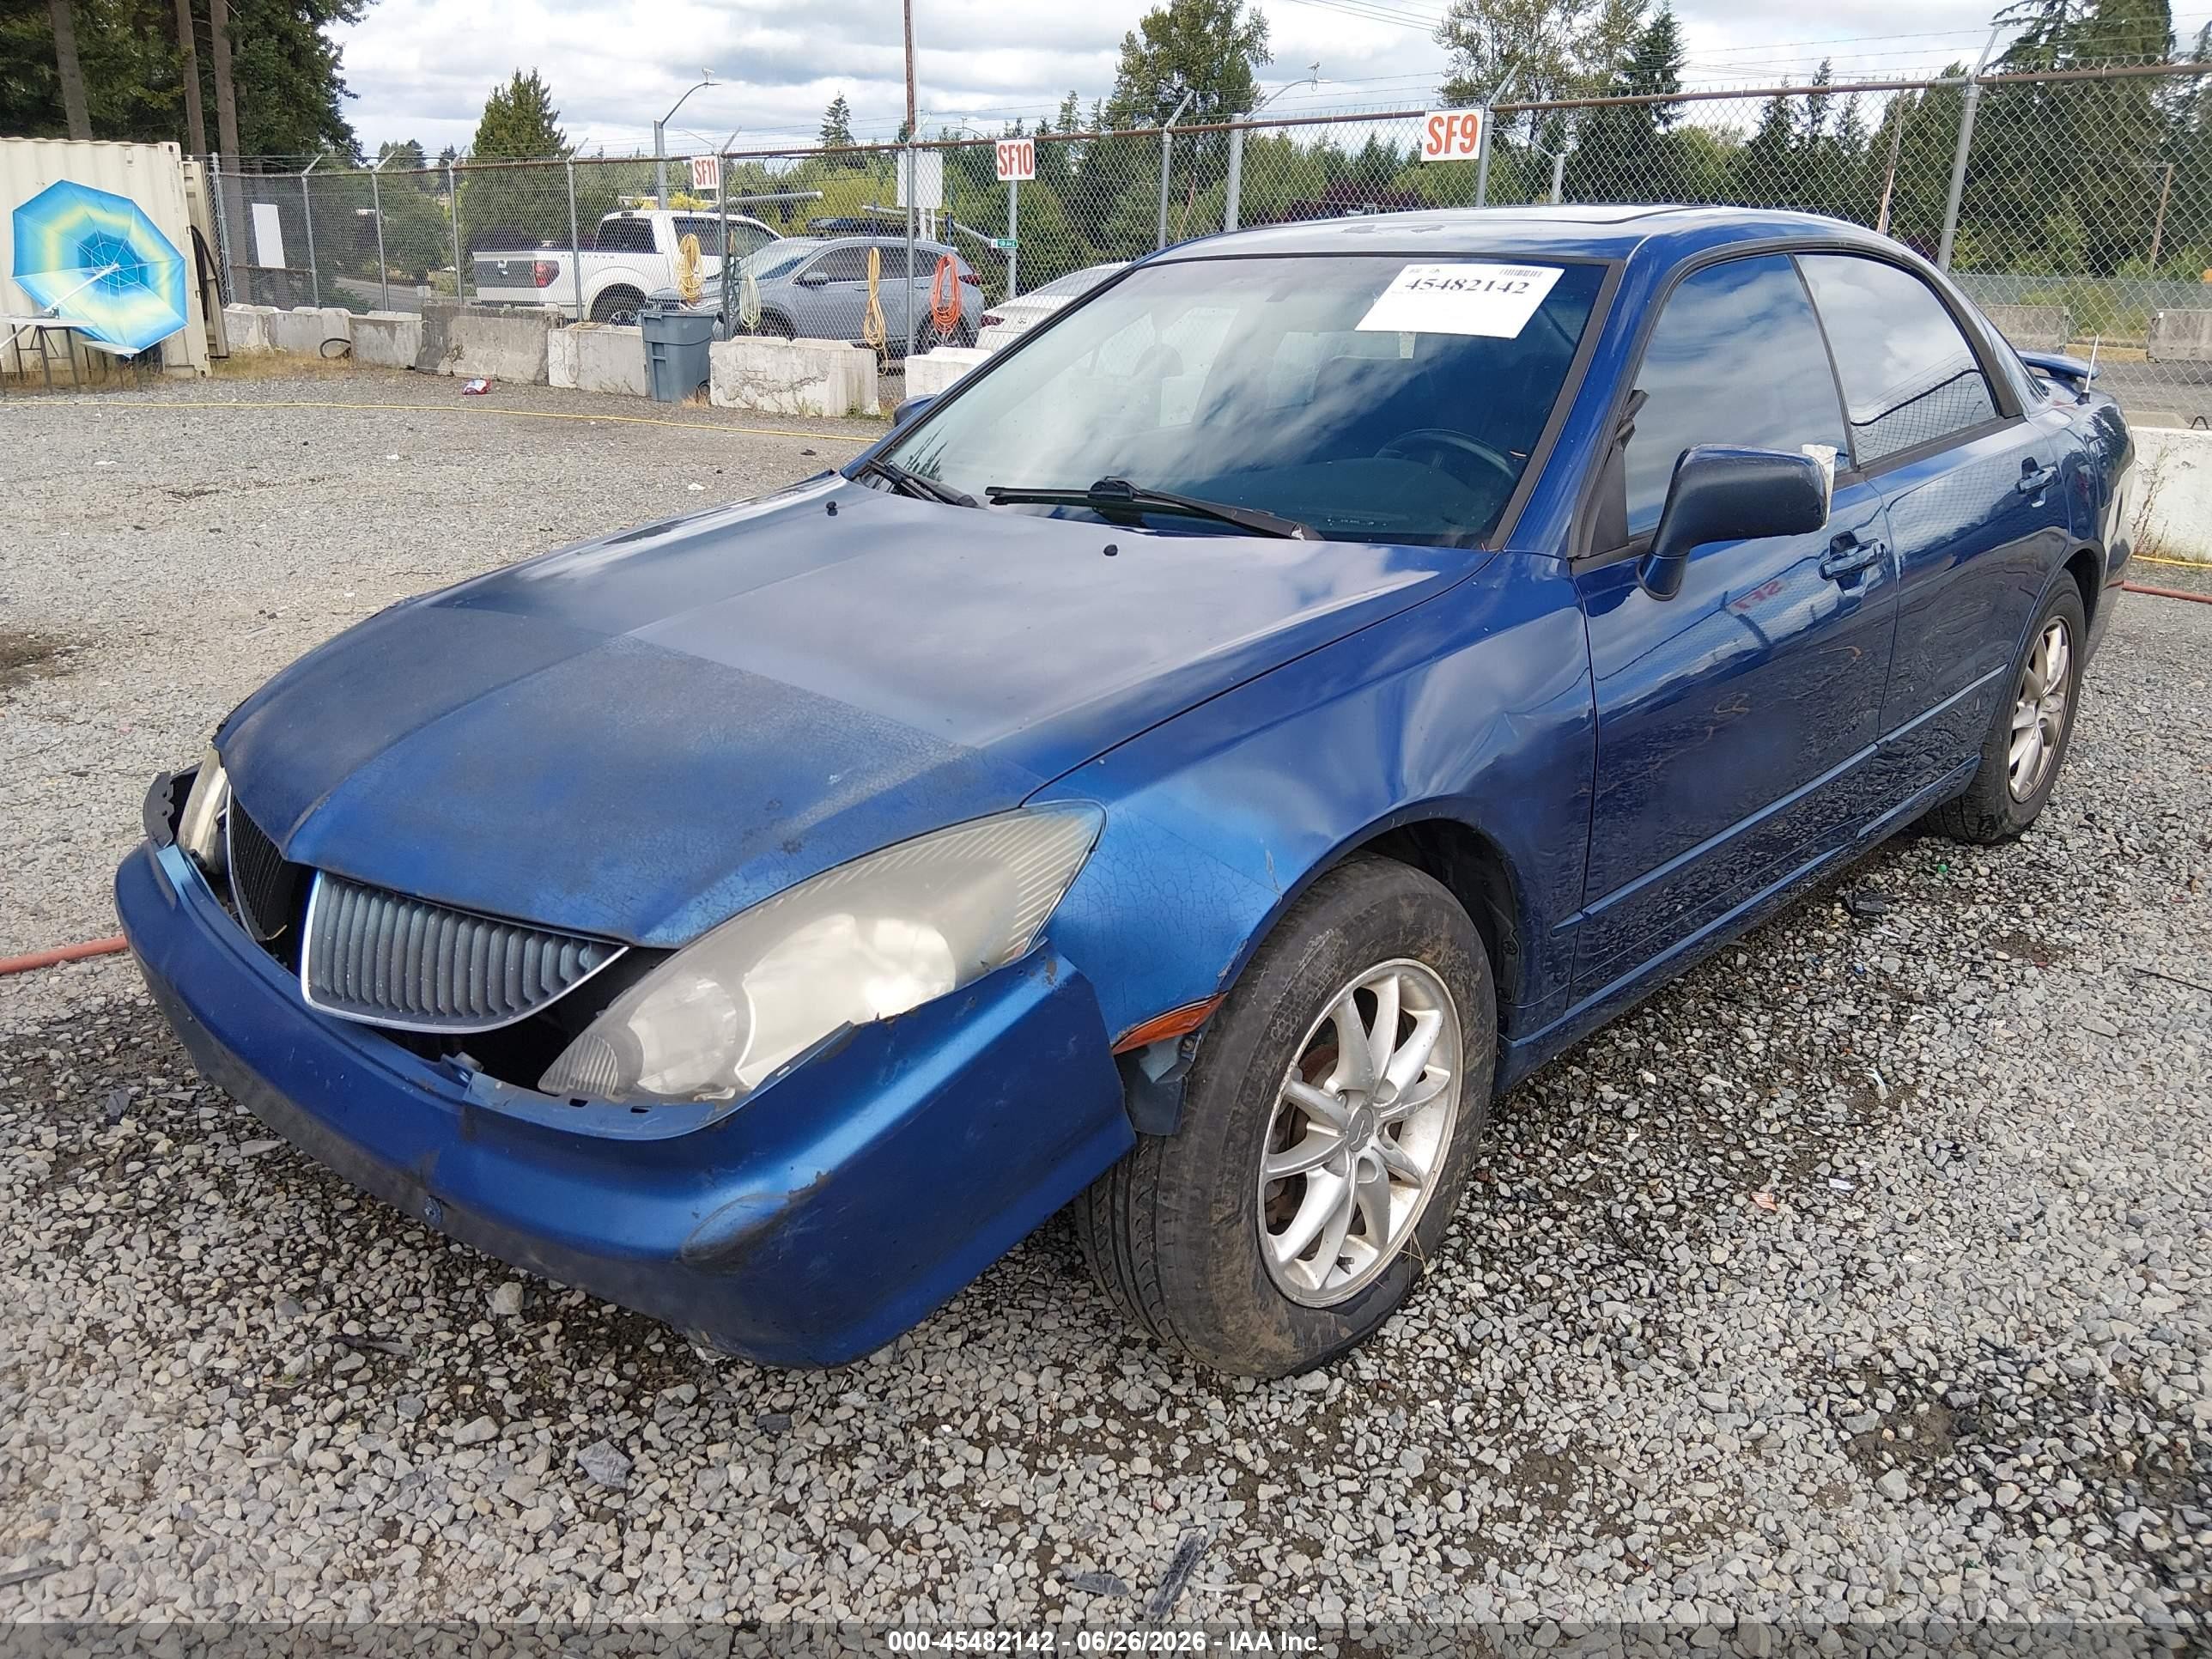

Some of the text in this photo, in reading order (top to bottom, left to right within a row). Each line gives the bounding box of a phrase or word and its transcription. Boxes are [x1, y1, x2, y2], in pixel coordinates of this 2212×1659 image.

[1426, 113, 1478, 155] SF9
[694, 159, 717, 185] SF11
[998, 143, 1033, 176] SF10
[1405, 277, 1530, 295] 45482142
